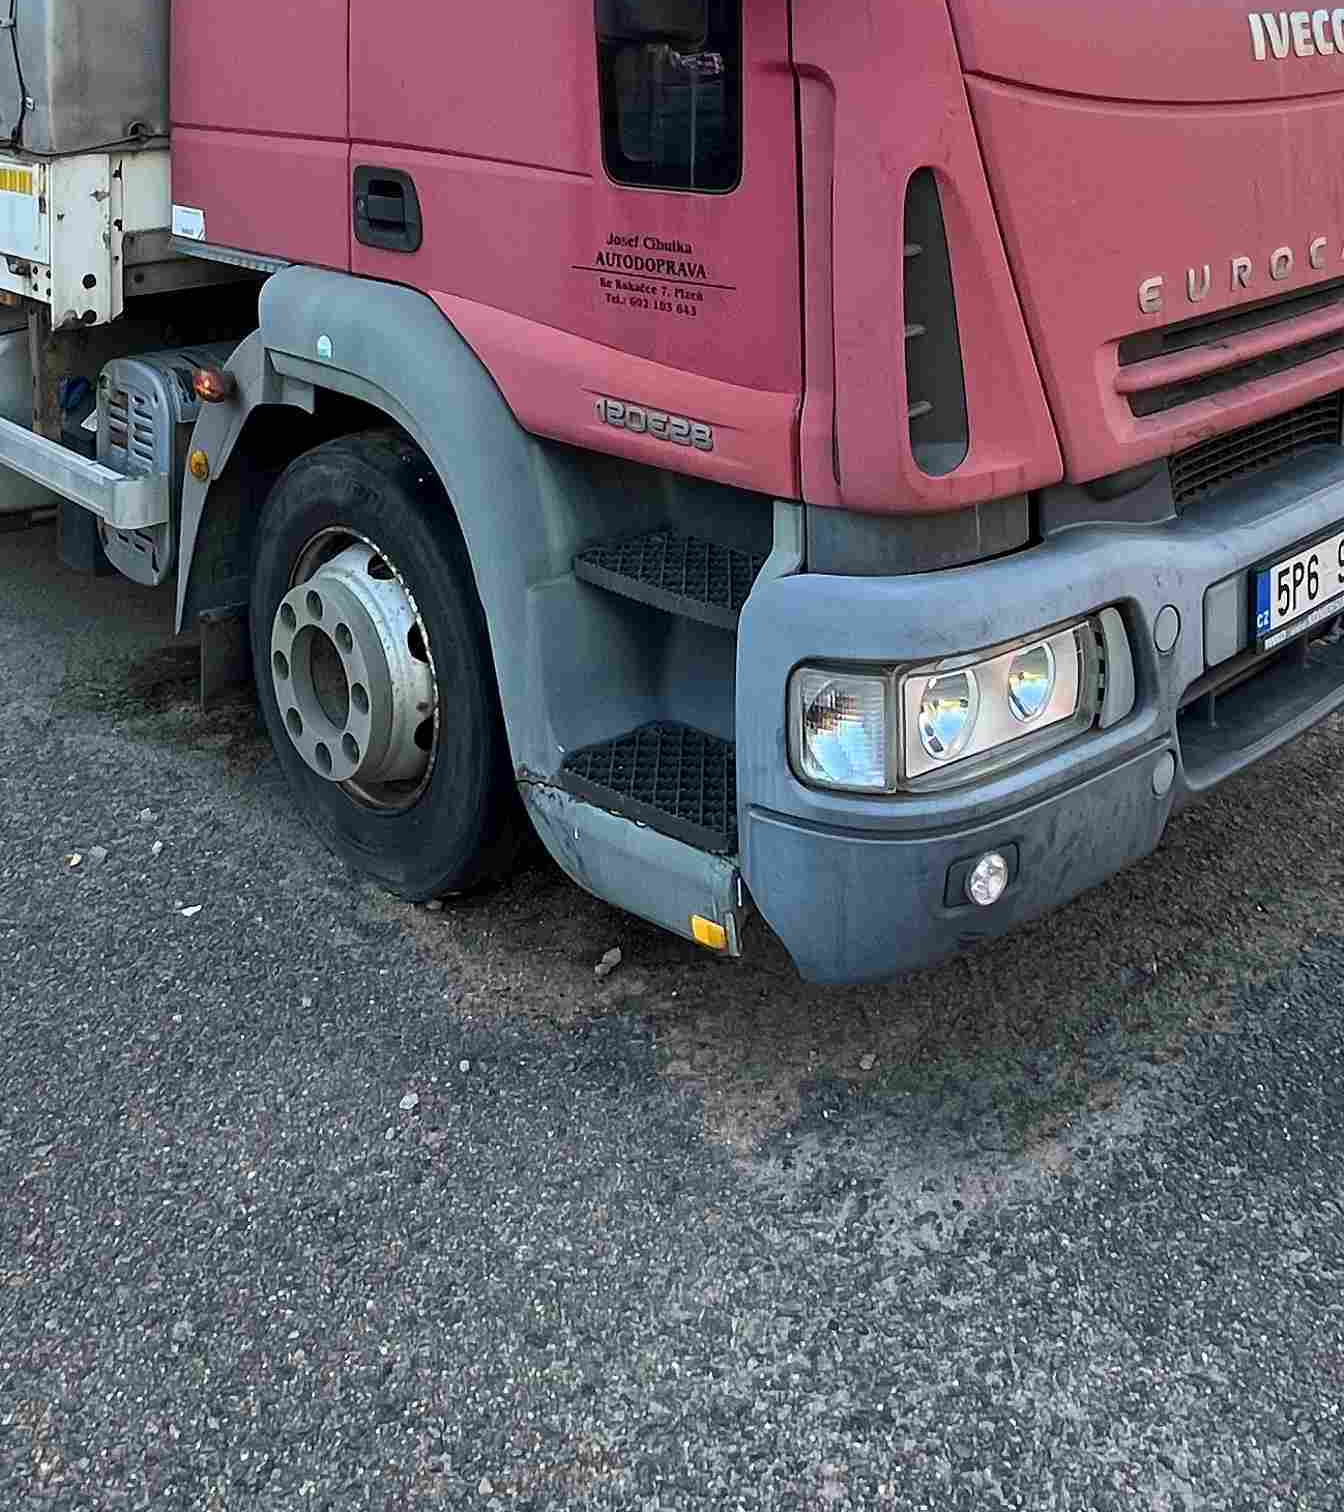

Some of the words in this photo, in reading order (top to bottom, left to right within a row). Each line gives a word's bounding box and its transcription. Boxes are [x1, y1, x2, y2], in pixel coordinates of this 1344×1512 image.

[607, 232, 639, 248] Josef
[643, 237, 692, 254] Cibulka
[596, 251, 706, 279] AUTODOPRAVA
[593, 399, 714, 452] 120E28
[1277, 554, 1319, 616] 5P6
[1257, 610, 1270, 628] CZ
